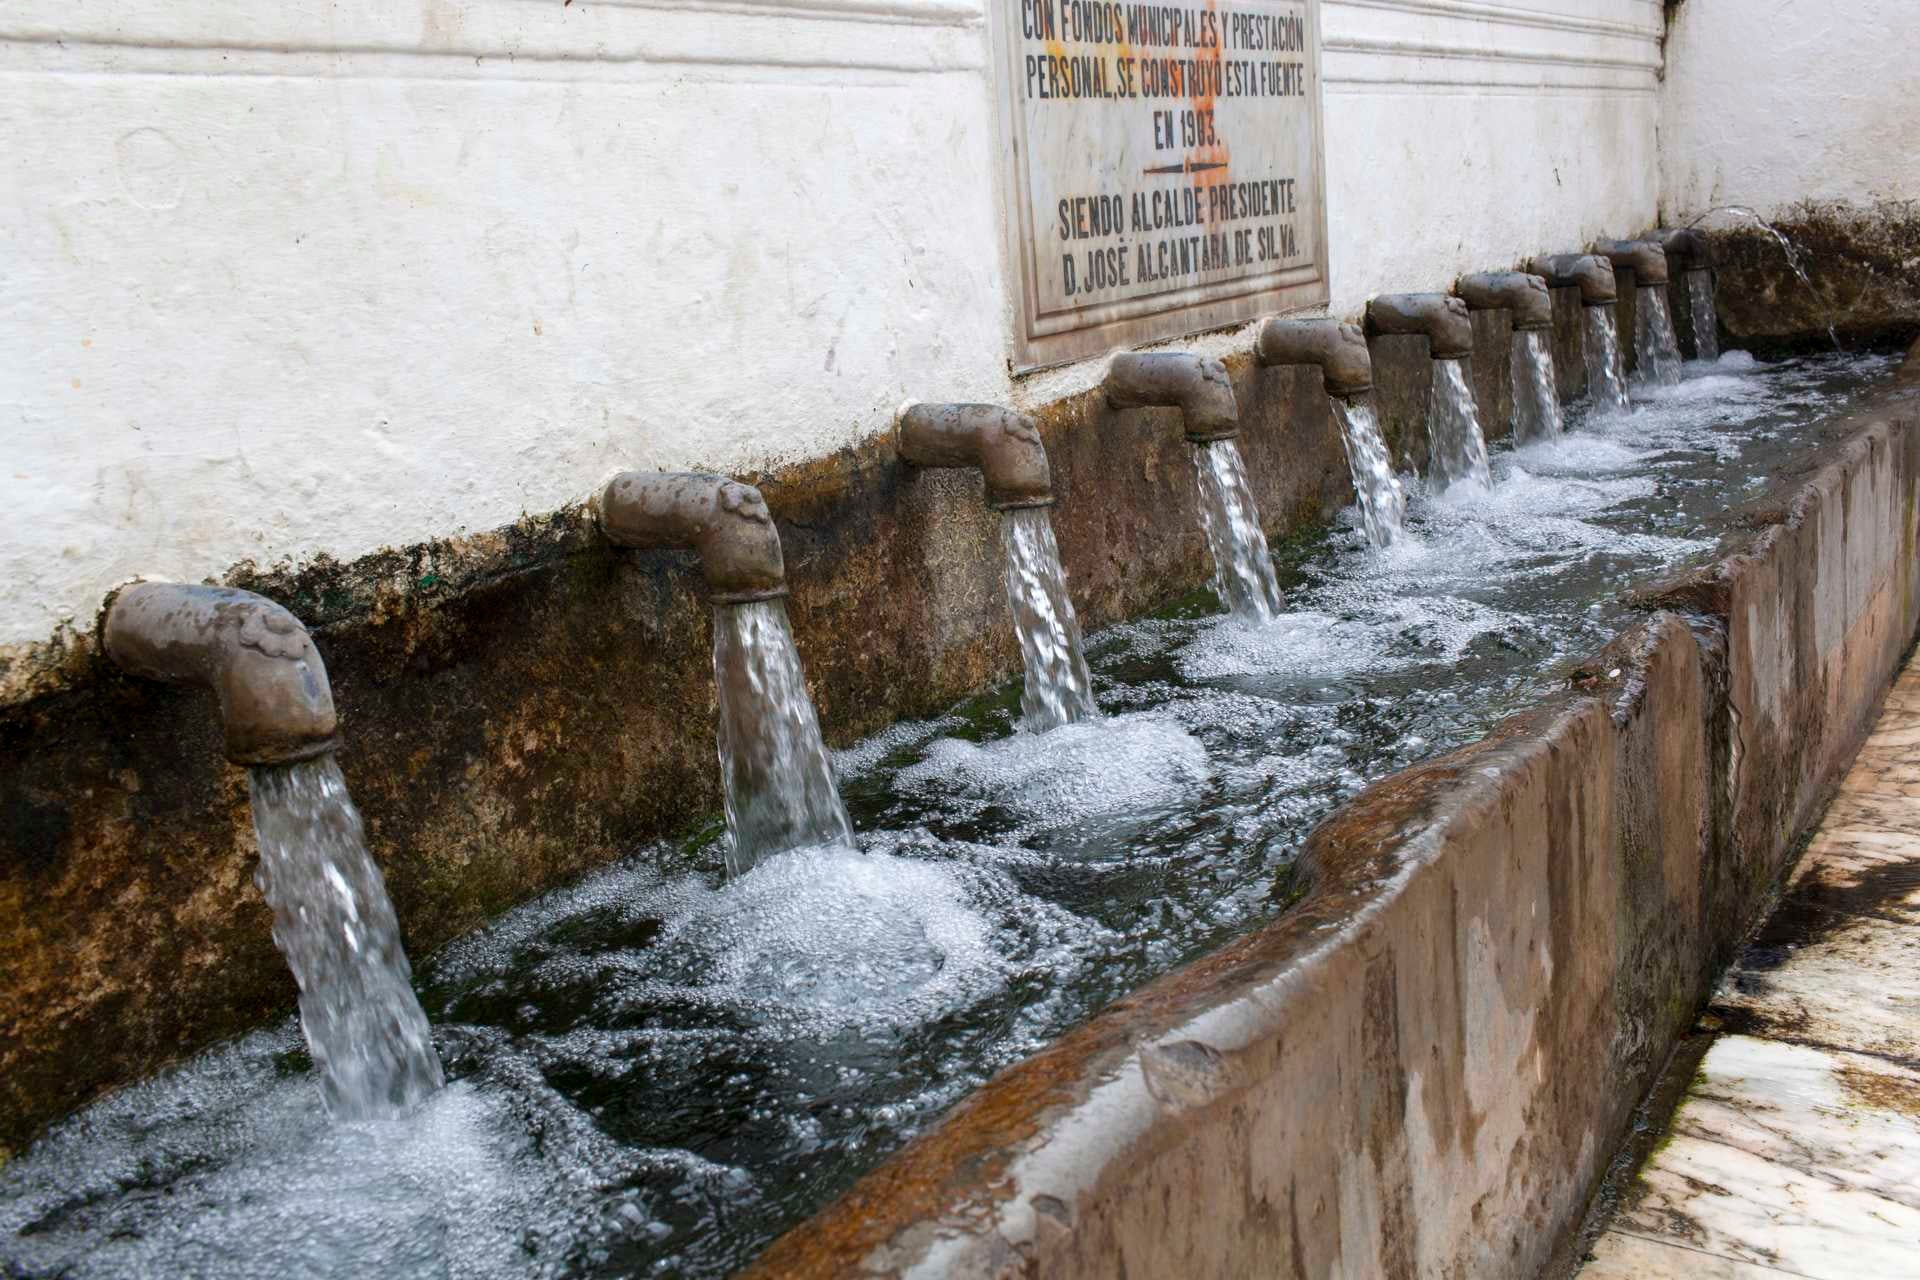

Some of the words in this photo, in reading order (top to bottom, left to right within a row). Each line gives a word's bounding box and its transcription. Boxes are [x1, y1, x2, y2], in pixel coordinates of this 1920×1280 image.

[1022, 0, 1056, 40] CON
[1061, 0, 1123, 44] FONDOS
[1127, 4, 1218, 48] MUNICIPALES
[1221, 11, 1229, 49] Y
[1233, 9, 1304, 52] PRESTACIÓN
[1141, 53, 1222, 98] CONSTRUYÓ
[1226, 60, 1258, 97] ESTA
[1261, 61, 1305, 97] FUENTE
[1153, 110, 1174, 150] EN
[1058, 194, 1124, 241] SIENDO
[1132, 186, 1204, 233] ALCALDE
[1209, 178, 1296, 222] PRESIDENTE
[1137, 232, 1230, 283] ALCANTARA
[1235, 229, 1253, 266] DE
[1258, 224, 1300, 262] SILVA.
